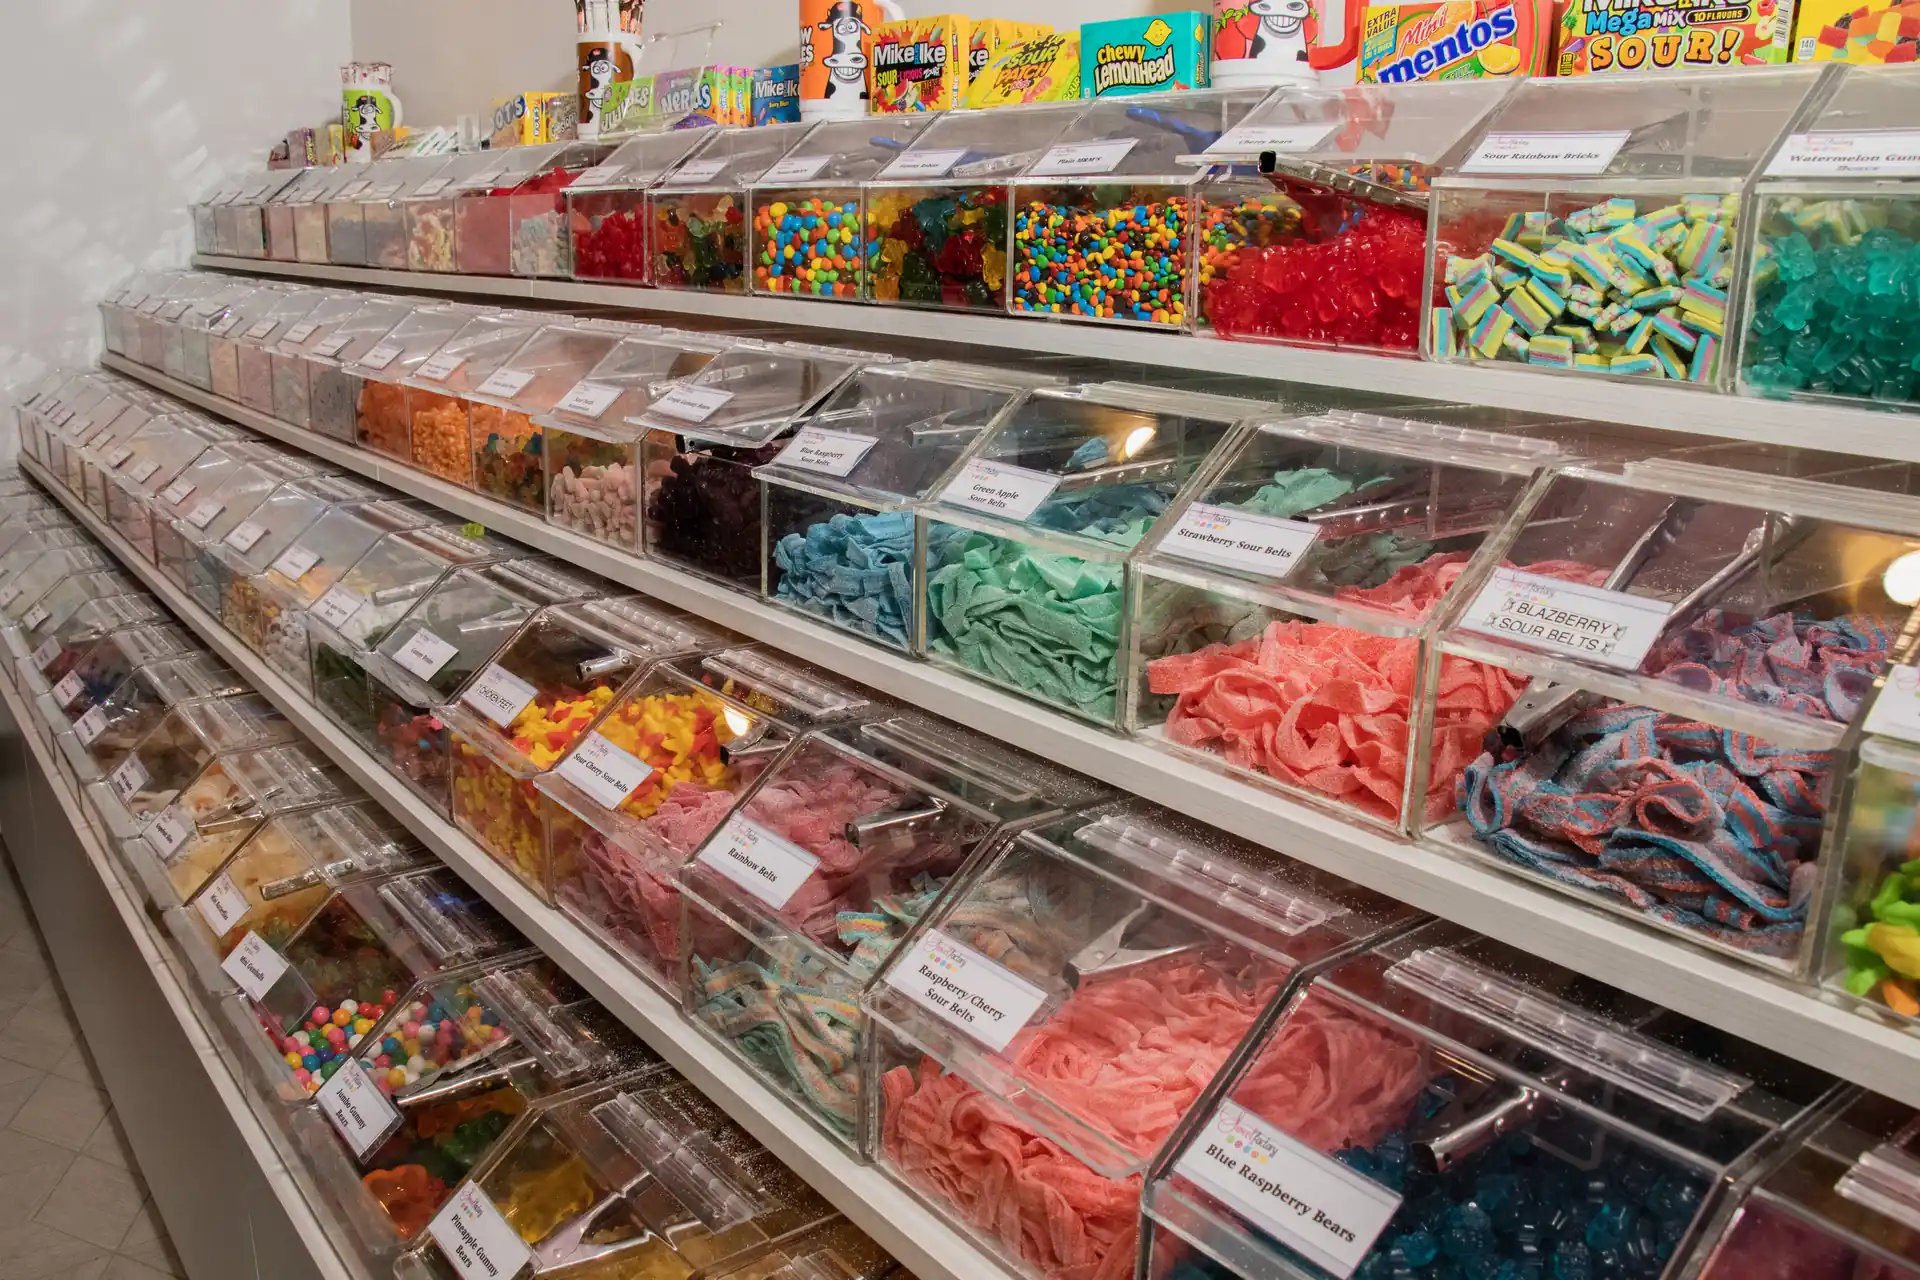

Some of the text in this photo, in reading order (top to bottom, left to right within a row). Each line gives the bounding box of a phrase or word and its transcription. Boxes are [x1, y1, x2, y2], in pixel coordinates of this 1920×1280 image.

[1367, 8, 1396, 28] EXTRA
[1367, 17, 1395, 38] VALUE
[1586, 8, 1650, 36] Mega
[1694, 9, 1743, 22] 10 FLAVORS
[1378, 6, 1516, 83] mentos
[1398, 6, 1447, 58] Mini
[873, 44, 914, 66] Mike
[919, 42, 947, 65] Ike
[969, 48, 989, 66] ke
[1004, 45, 1060, 69] SOUR
[1097, 44, 1146, 65] chewy
[1590, 29, 1740, 71] SOUR!
[999, 60, 1055, 83] PATCH
[755, 79, 800, 98] Mike Ik
[1482, 152, 1507, 160] Sour
[1509, 152, 1561, 160] Rainbow
[1790, 154, 1880, 162] Watermelon
[799, 446, 845, 459] Blue Raspberry
[968, 493, 1008, 509] Sour Belts
[972, 484, 1019, 500] Green Apple
[1177, 527, 1292, 559] Strawberry Sour Belts
[1516, 602, 1613, 634] BLAZBERRY
[1498, 617, 1600, 650] SOUR BELTS
[479, 685, 512, 711] CHICKEN FEET
[573, 752, 628, 793] Sour Cherry Sour Belts
[727, 847, 778, 883] Rainbow Belts
[239, 955, 265, 982] Mini Gumballs
[918, 963, 1007, 1022] Raspberry/Cherry
[924, 987, 976, 1024] Sour Belts
[335, 1108, 349, 1128] Bears
[336, 1088, 351, 1109] Jumbo
[350, 1105, 367, 1130] Gummy
[1205, 1143, 1357, 1243] Blue Raspberry Bears
[451, 1213, 499, 1278] Pineapple Gummy
[455, 1244, 473, 1269] Bears
